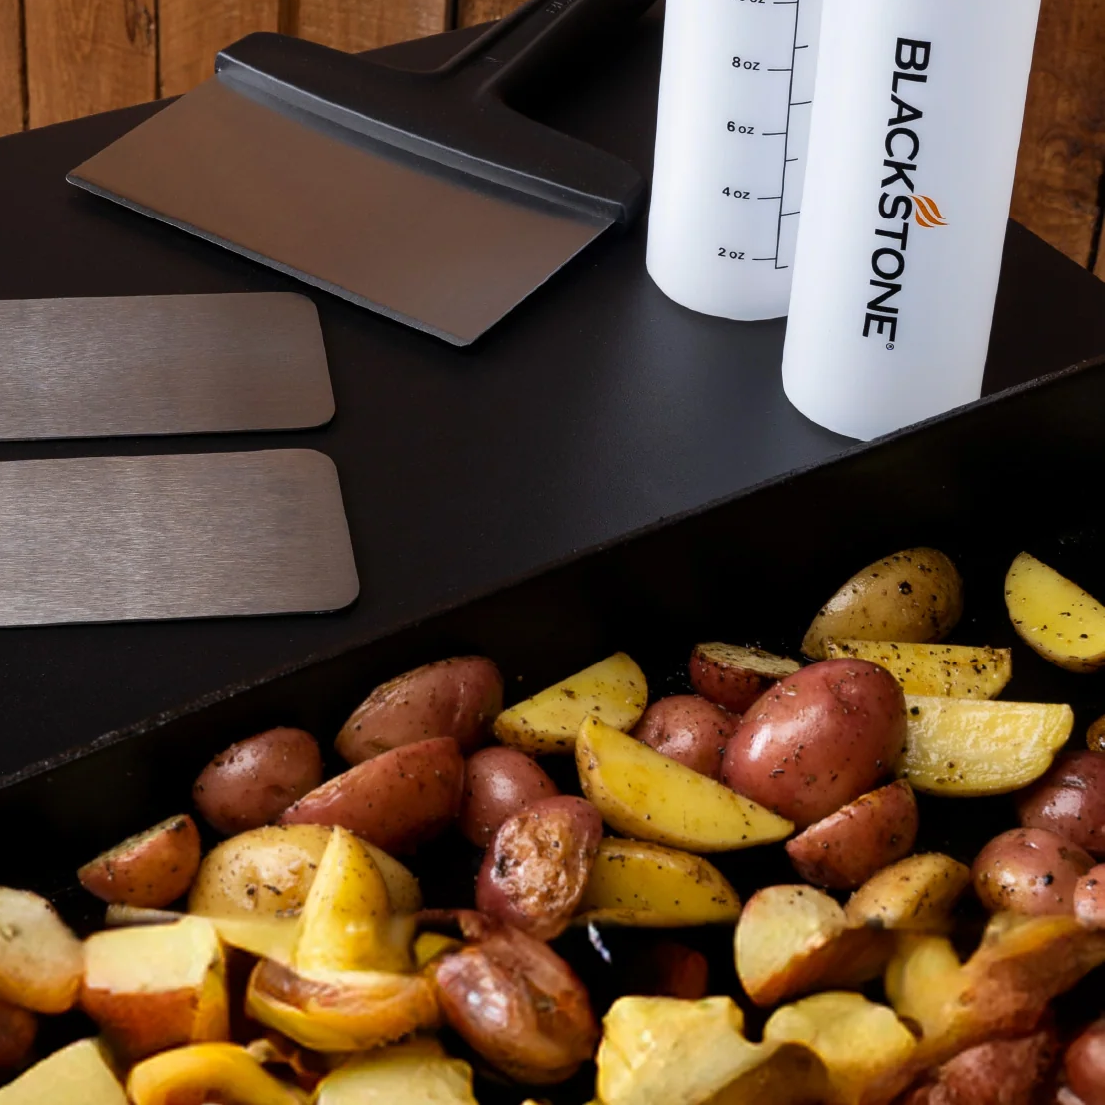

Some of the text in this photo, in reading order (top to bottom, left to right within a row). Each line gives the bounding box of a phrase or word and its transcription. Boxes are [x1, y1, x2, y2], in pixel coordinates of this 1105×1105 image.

[731, 55, 742, 69] 8
[726, 120, 736, 133] 6
[721, 186, 732, 198] 4
[717, 246, 727, 258] 2
